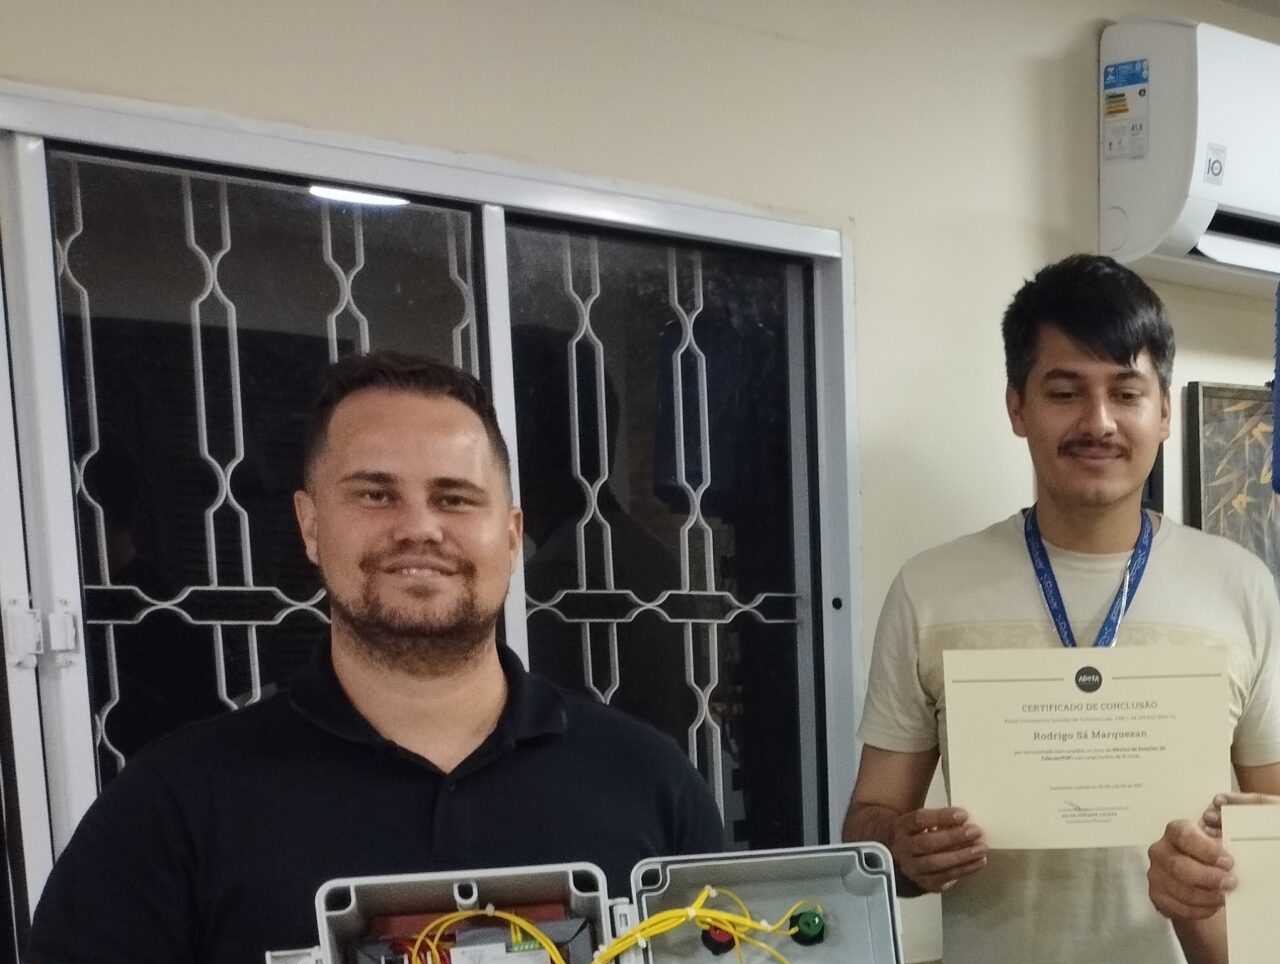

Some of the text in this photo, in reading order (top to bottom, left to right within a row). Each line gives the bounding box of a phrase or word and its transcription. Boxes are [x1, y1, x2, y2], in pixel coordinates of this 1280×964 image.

[1021, 700, 1158, 712] CERTIFICADO DE CONCLUSÃO
[1033, 731, 1074, 742] Rodrigo
